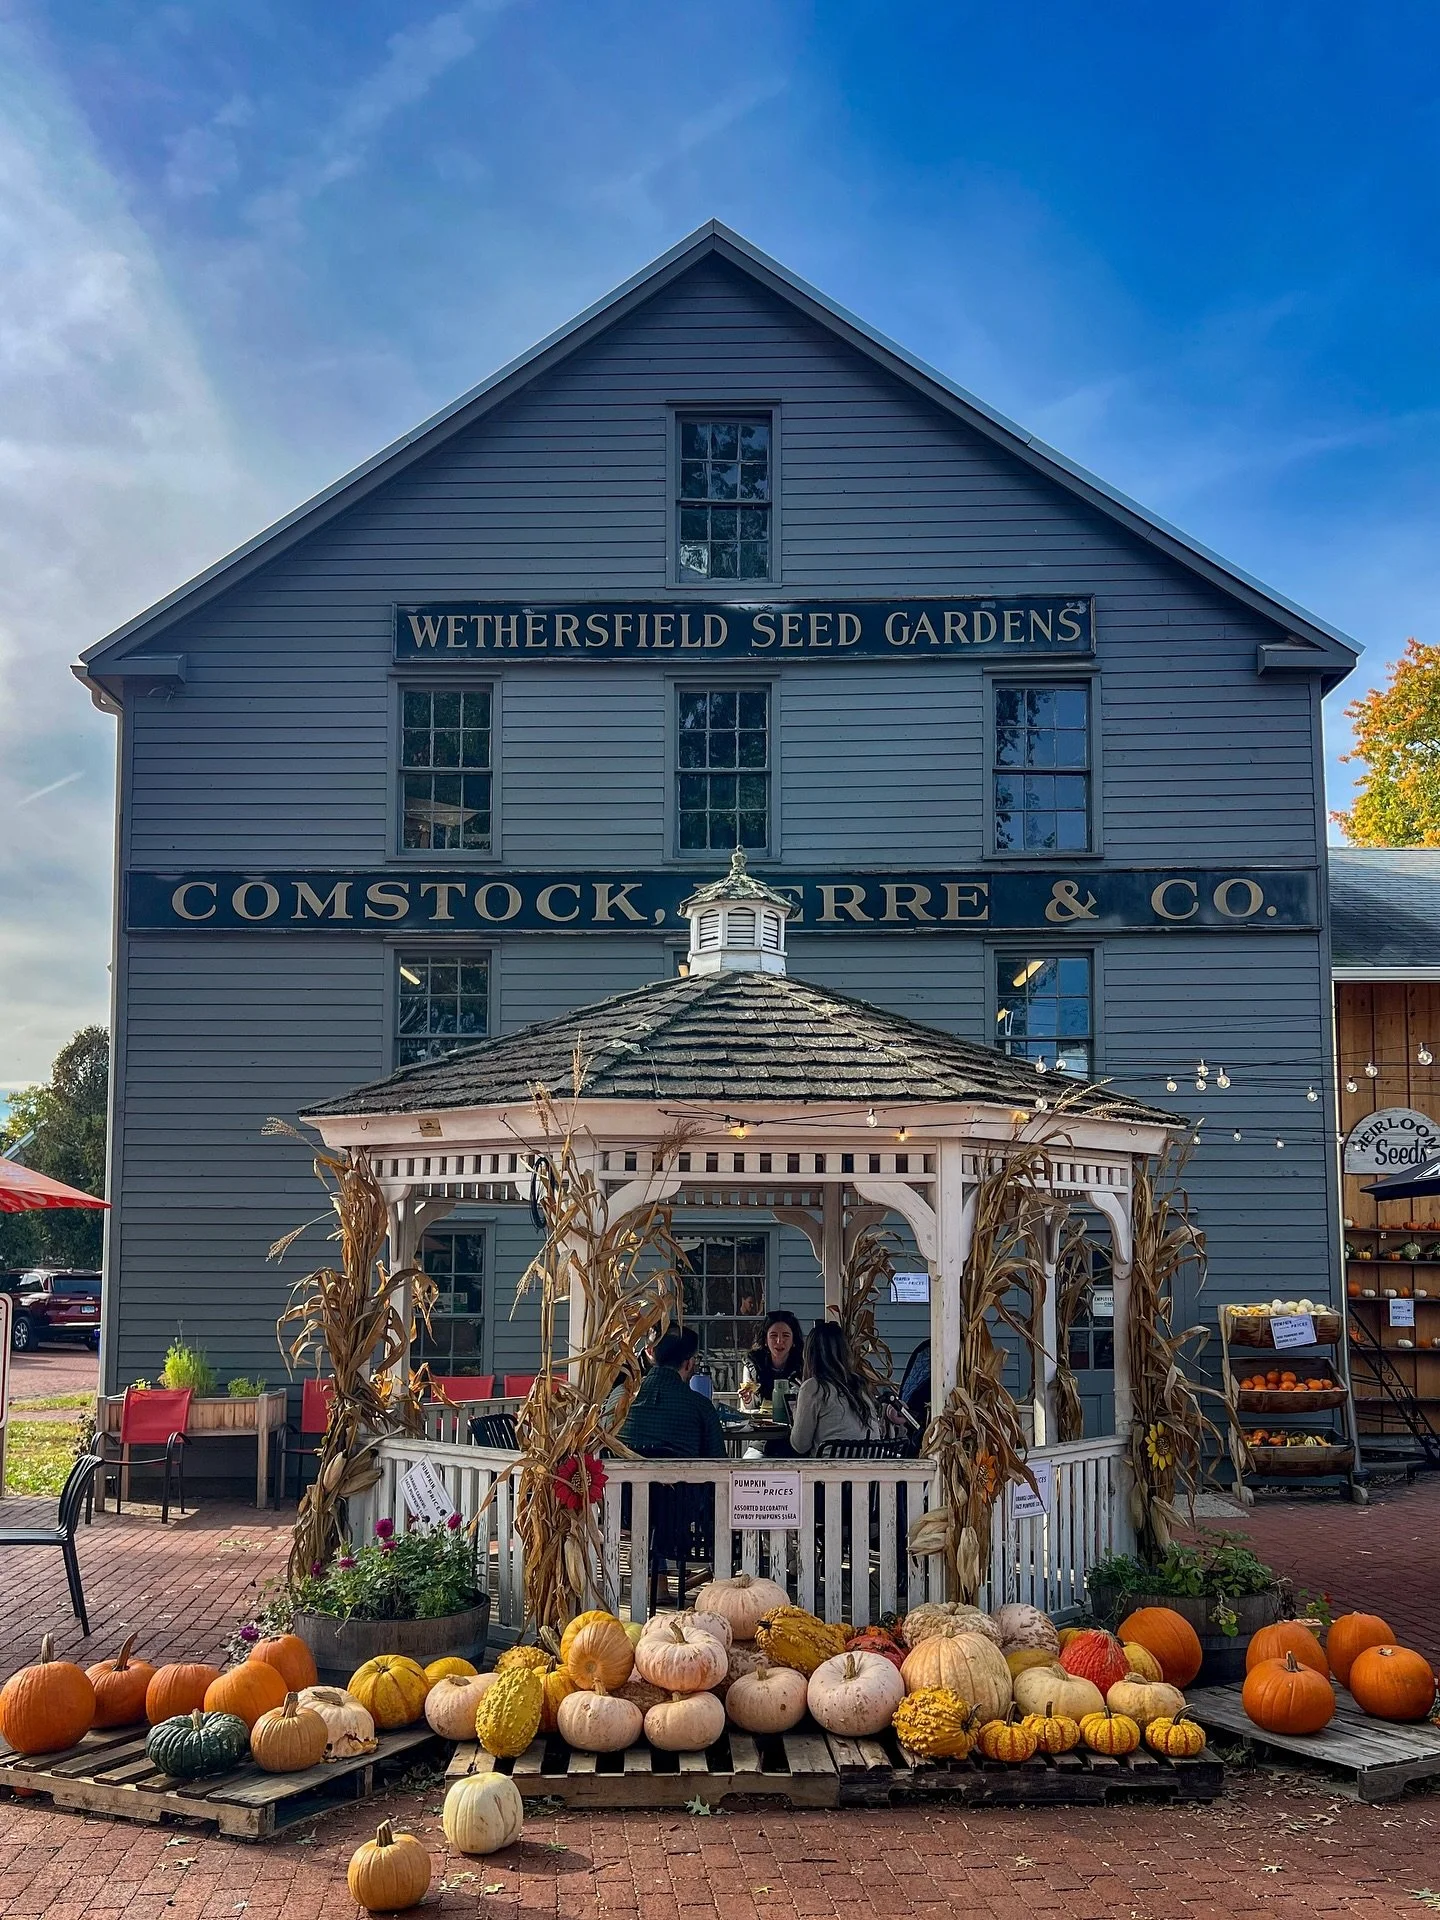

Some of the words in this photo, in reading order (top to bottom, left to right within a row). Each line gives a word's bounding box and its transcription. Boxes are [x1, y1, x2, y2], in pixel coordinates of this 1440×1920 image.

[408, 612, 728, 650] WETHERSFIELD
[751, 612, 862, 647] SEED
[885, 608, 1082, 645] GARDENS
[171, 881, 666, 926] COMSTOCK,
[1045, 880, 1099, 922] &
[1150, 878, 1278, 920] CO.
[421, 1462, 436, 1489] PUMPKIN
[734, 1479, 767, 1488] PUMPKIN
[427, 1489, 443, 1516] PRICE
[763, 1488, 794, 1496] PRICES
[733, 1504, 759, 1512] ASSORTED
[759, 1504, 789, 1512] DECORATIVE
